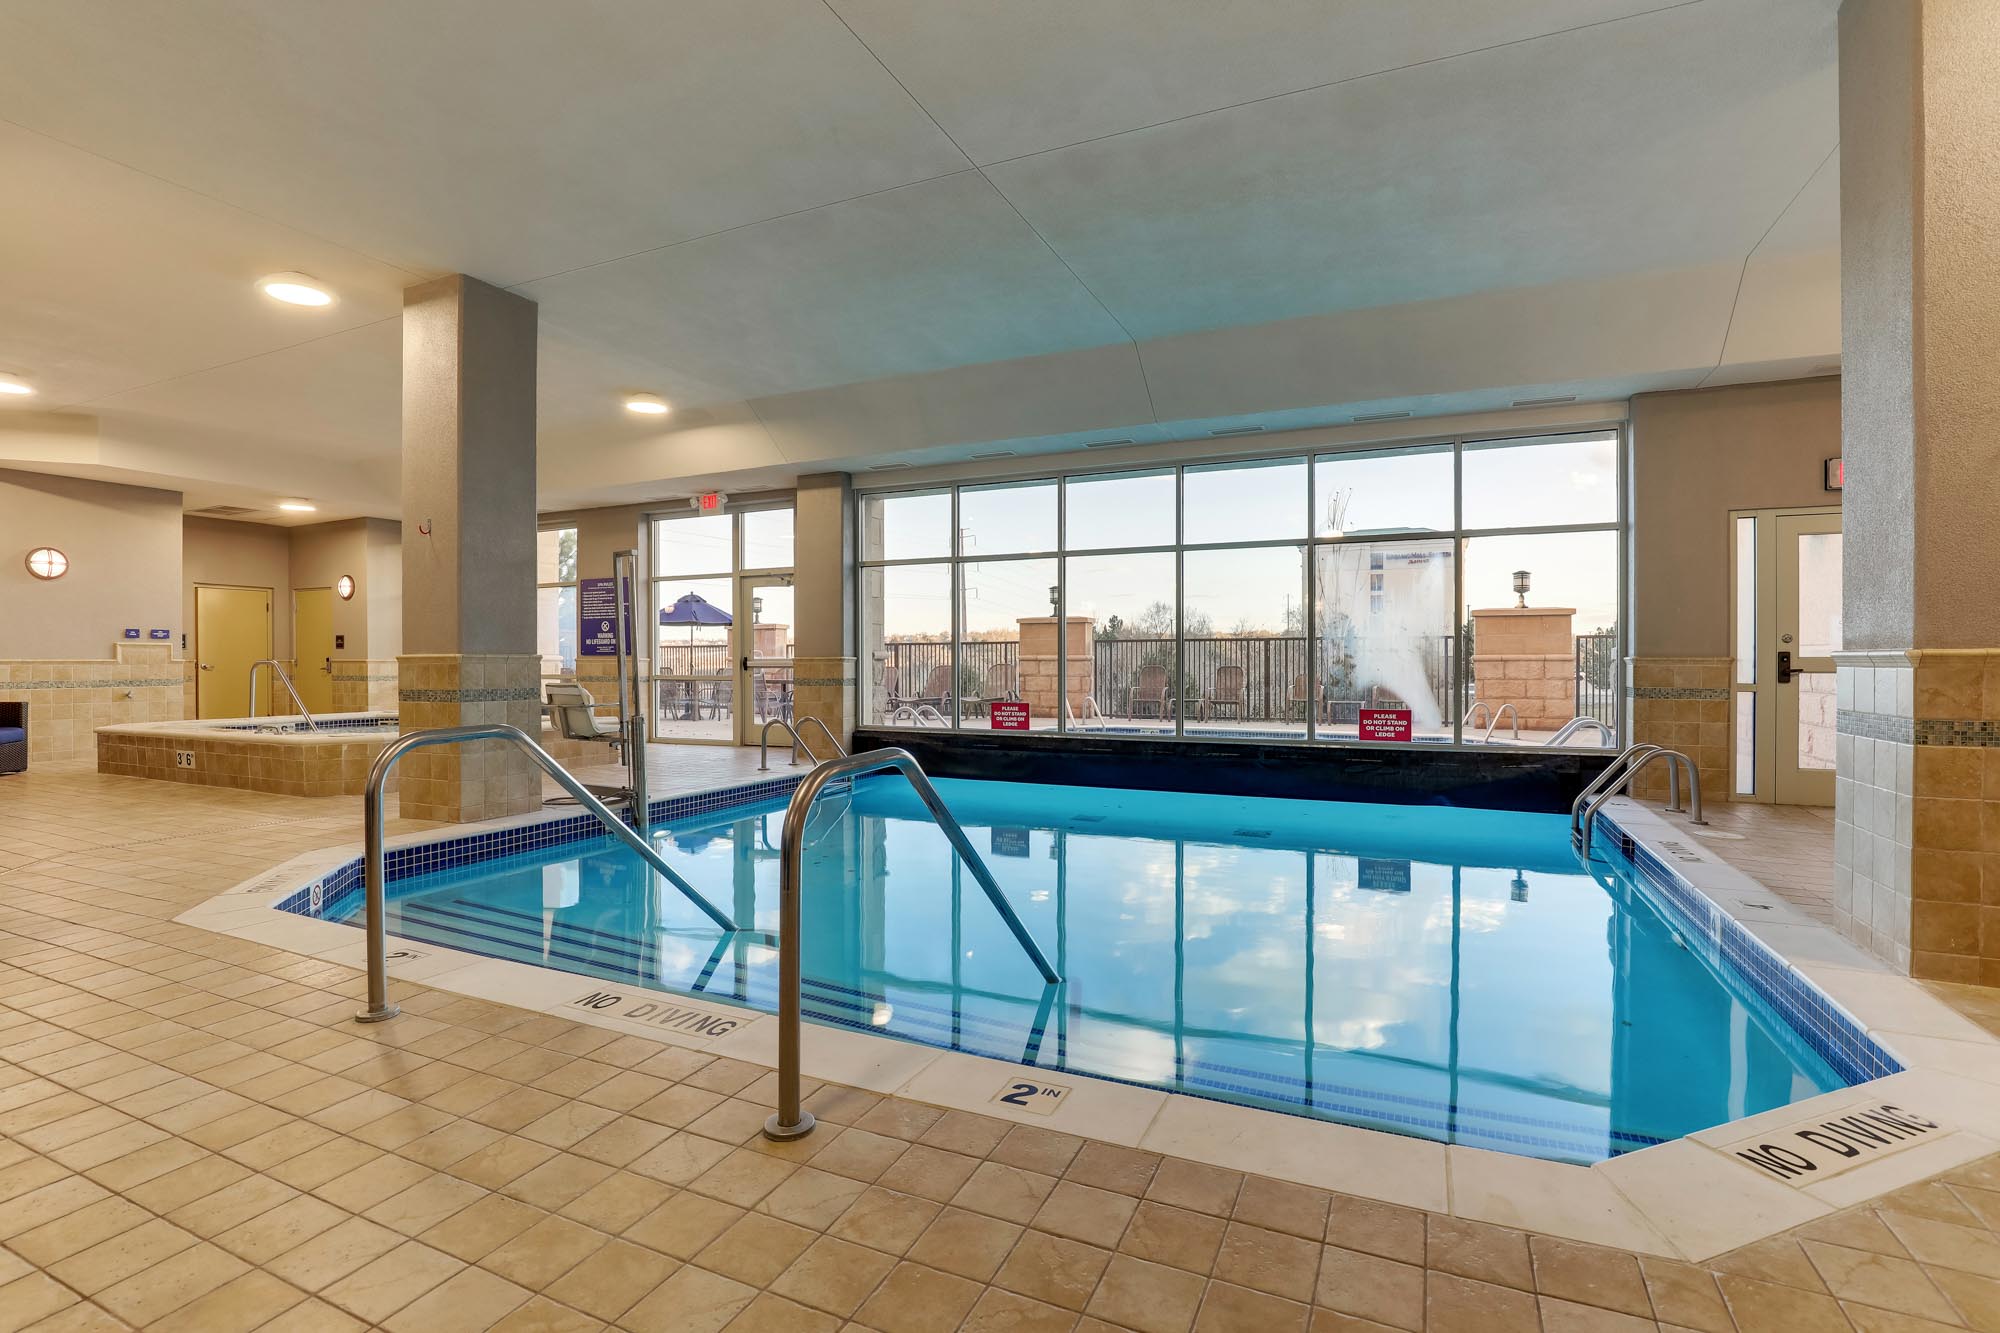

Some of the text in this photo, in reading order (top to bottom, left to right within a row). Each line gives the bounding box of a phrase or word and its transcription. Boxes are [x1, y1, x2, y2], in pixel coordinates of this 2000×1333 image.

[703, 495, 717, 510] EXIT
[574, 991, 737, 1037] NO DIVING
[1000, 1083, 1062, 1106] 2 IN
[1735, 1104, 1939, 1180] NO DIVING
